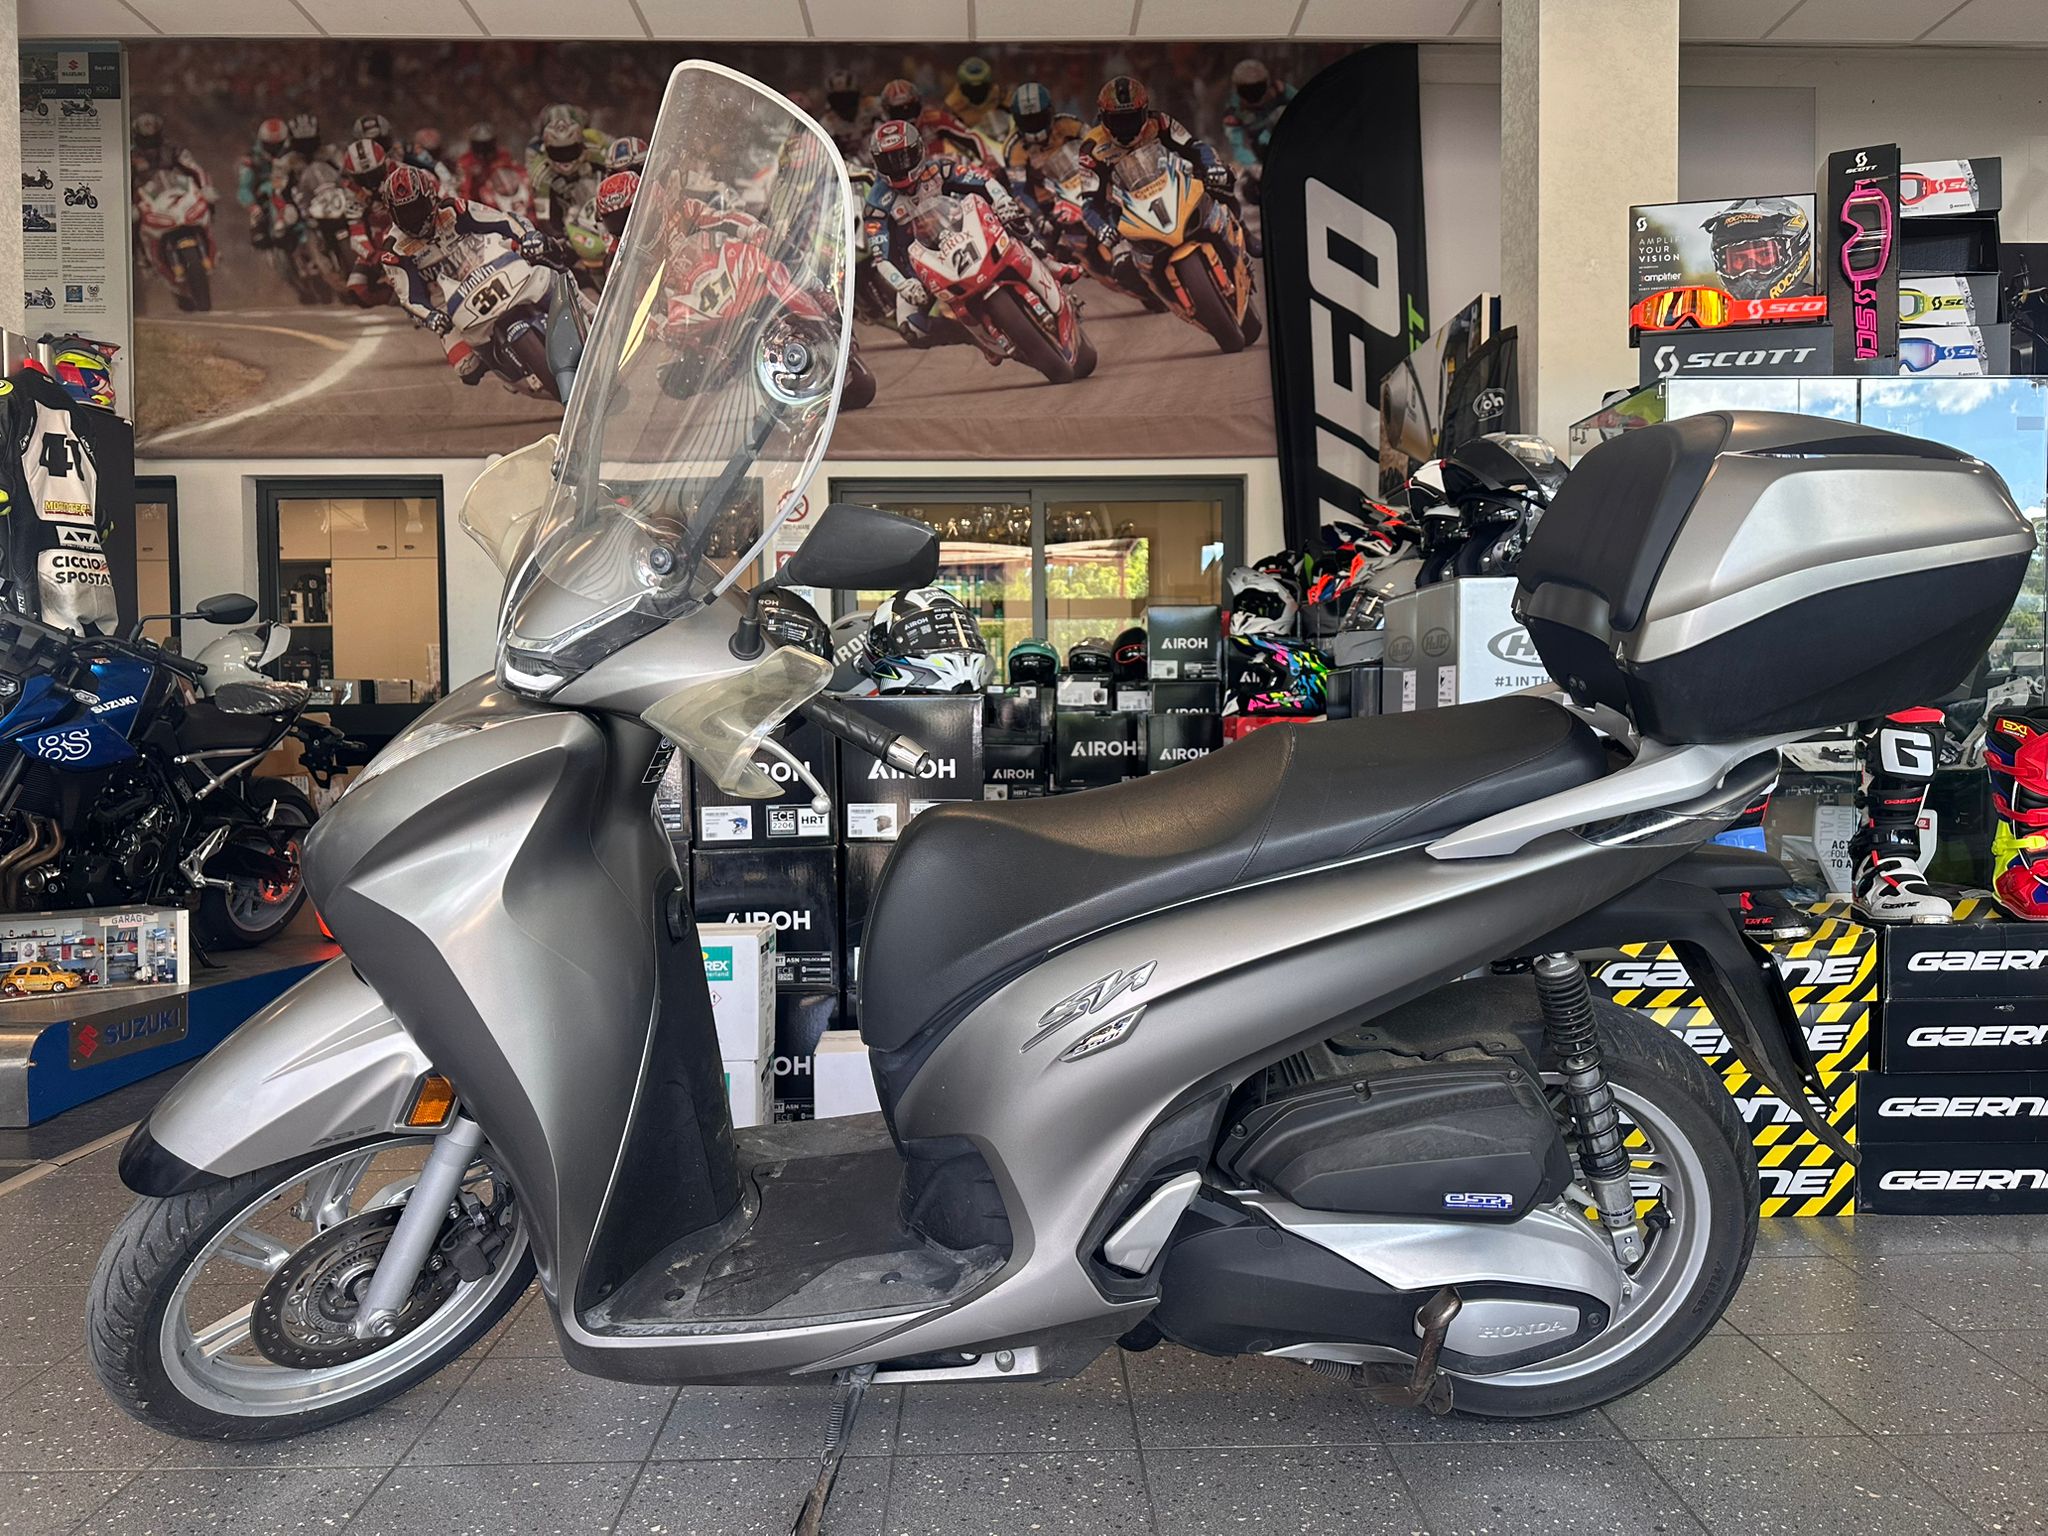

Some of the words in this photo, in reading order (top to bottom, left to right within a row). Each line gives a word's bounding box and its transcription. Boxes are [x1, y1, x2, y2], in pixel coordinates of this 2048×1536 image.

[1845, 165, 1877, 174] SCOTT
[936, 230, 974, 264] XEROX
[1639, 246, 1670, 254] YOUR
[952, 241, 982, 277] 21
[1638, 254, 1681, 263] VISION
[457, 265, 497, 298] WinWin
[1682, 347, 1817, 369] SCOTT
[52, 556, 101, 570] CICCIO
[904, 616, 930, 631] AIROH
[1161, 637, 1208, 649] AIROH
[1494, 676, 1513, 687] #1
[1515, 676, 1530, 687] IN
[90, 695, 138, 714] SUZUKI
[1070, 740, 1137, 757] AIROH
[1159, 747, 1210, 761] AIROH
[992, 769, 1035, 780] AIROH
[772, 811, 795, 821] ECE
[801, 815, 825, 825] HRT
[773, 821, 794, 829] 2206
[1831, 859, 1843, 868] TO
[111, 914, 149, 925] GARAGE
[105, 1007, 182, 1047] SUZUKI
[1478, 1321, 1568, 1339] HONDA
